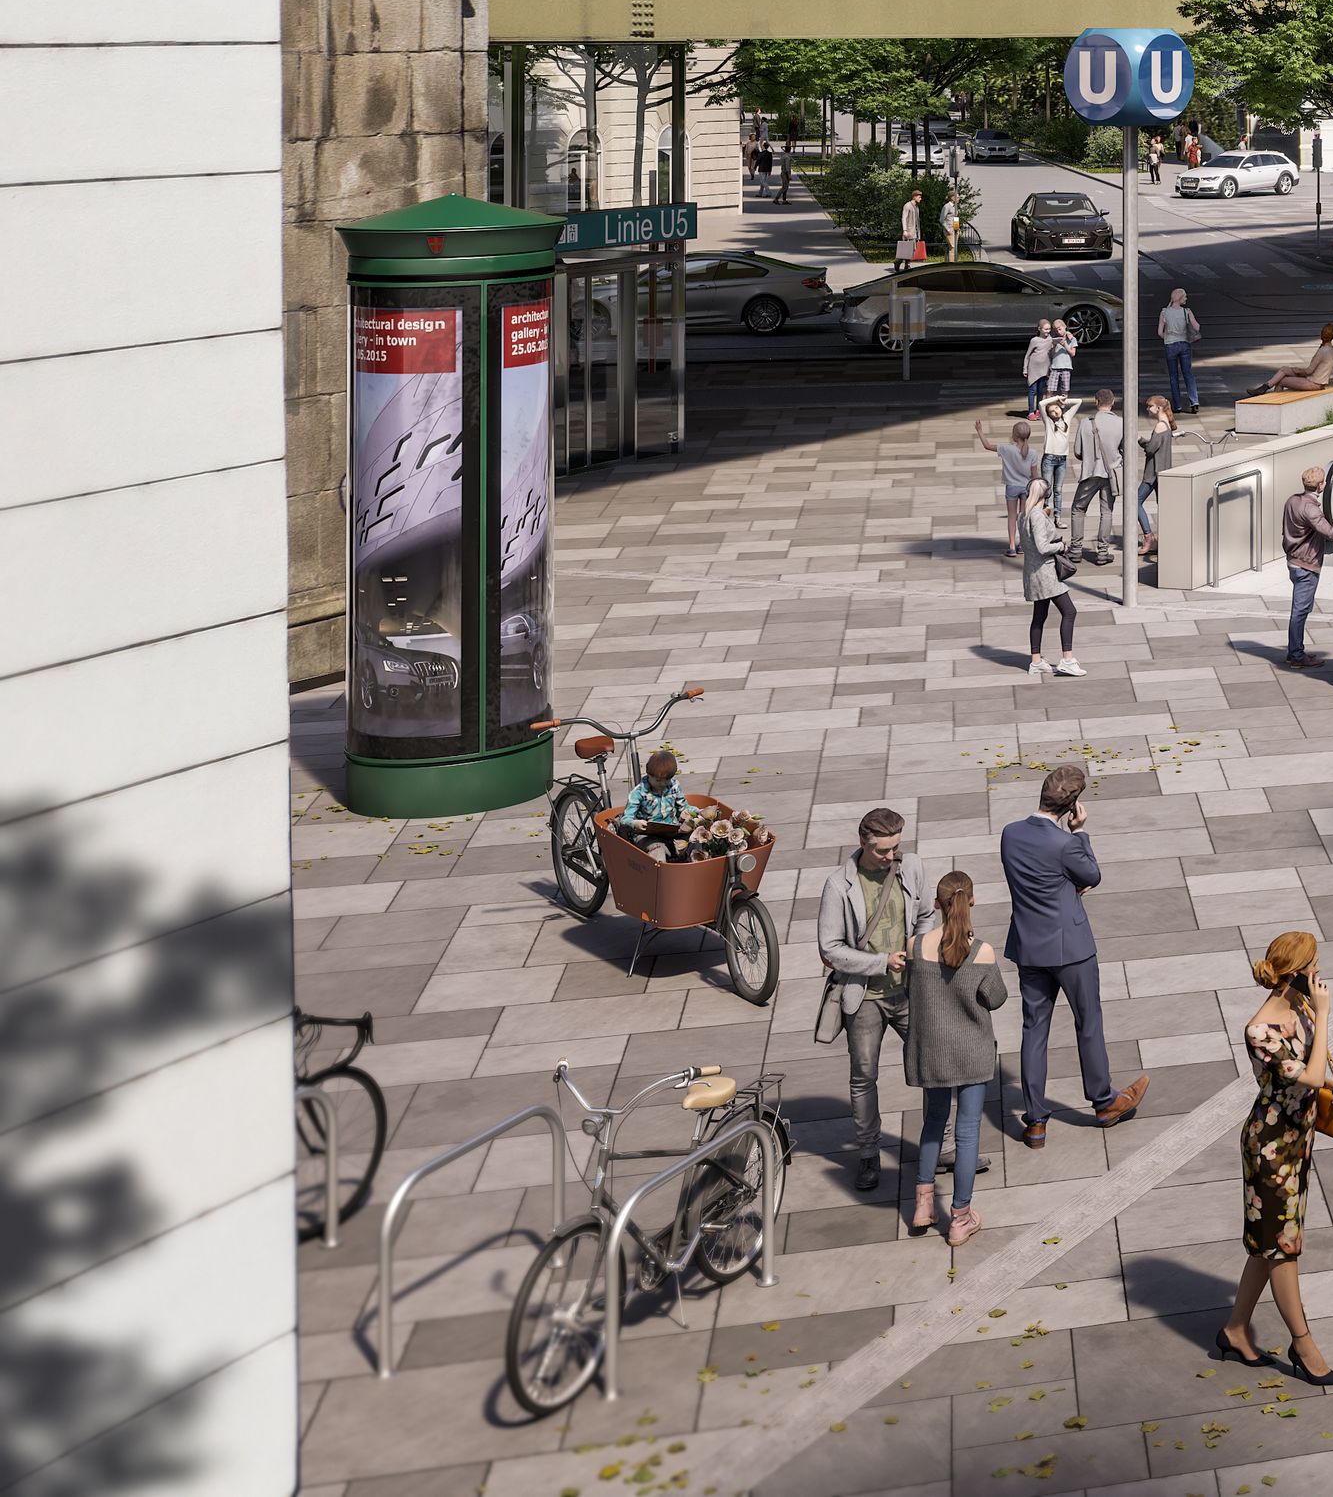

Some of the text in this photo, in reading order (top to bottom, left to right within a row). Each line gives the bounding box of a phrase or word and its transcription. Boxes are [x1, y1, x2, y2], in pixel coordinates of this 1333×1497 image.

[1078, 50, 1117, 105] U
[1151, 50, 1183, 104] U
[605, 208, 688, 244] Linie U5
[397, 318, 446, 333] design
[511, 327, 540, 343] gallery
[375, 334, 384, 346] in
[386, 335, 417, 346] town
